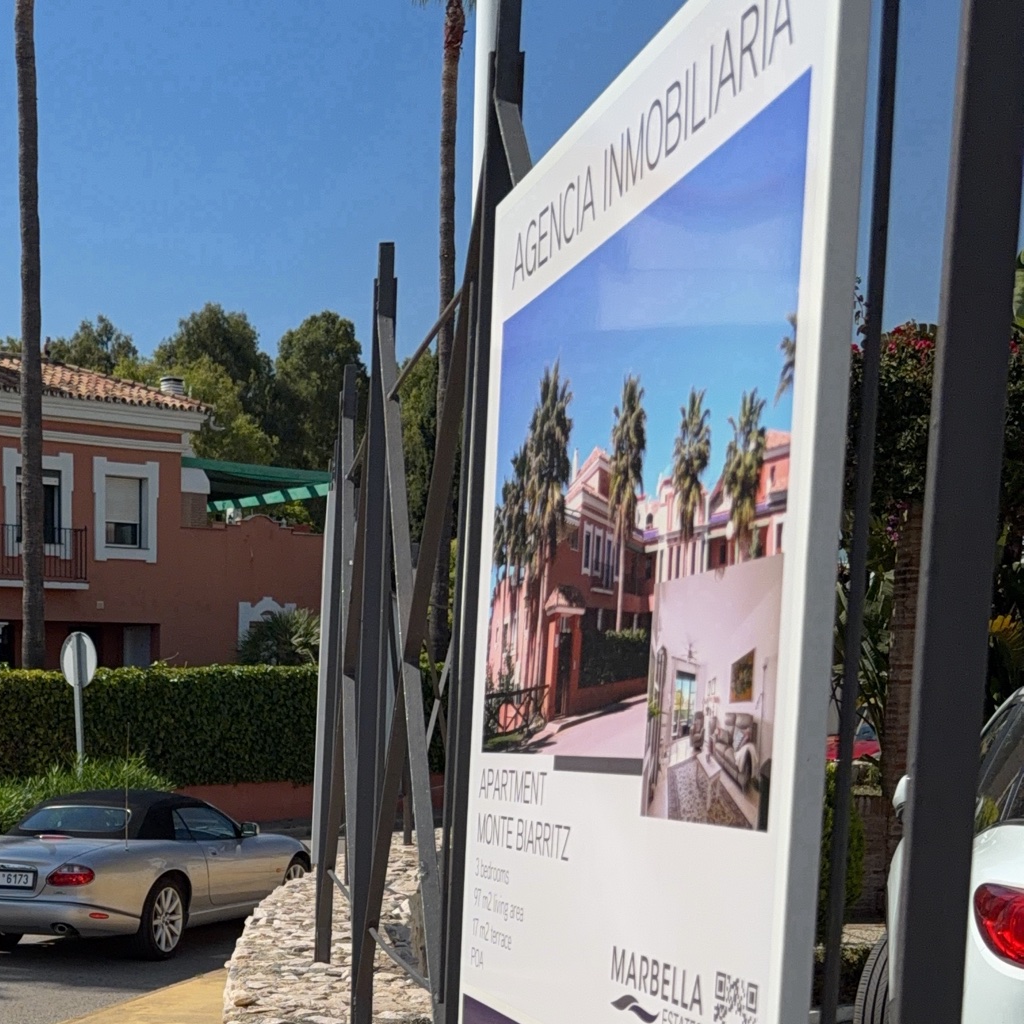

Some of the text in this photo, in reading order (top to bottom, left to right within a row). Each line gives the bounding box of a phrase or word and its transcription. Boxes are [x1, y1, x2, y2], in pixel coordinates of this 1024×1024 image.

[511, 0, 794, 291] AGENCIA INMOBILIARIA
[478, 768, 548, 806] APARTMENT
[476, 812, 571, 861] MONTE BIARRITZ
[6, 873, 29, 885] 6173
[474, 857, 510, 885] 3 bedrooms
[473, 887, 482, 907] 97
[509, 904, 525, 923] area
[490, 926, 512, 951] terrace
[610, 945, 703, 1016] MARBELLA
